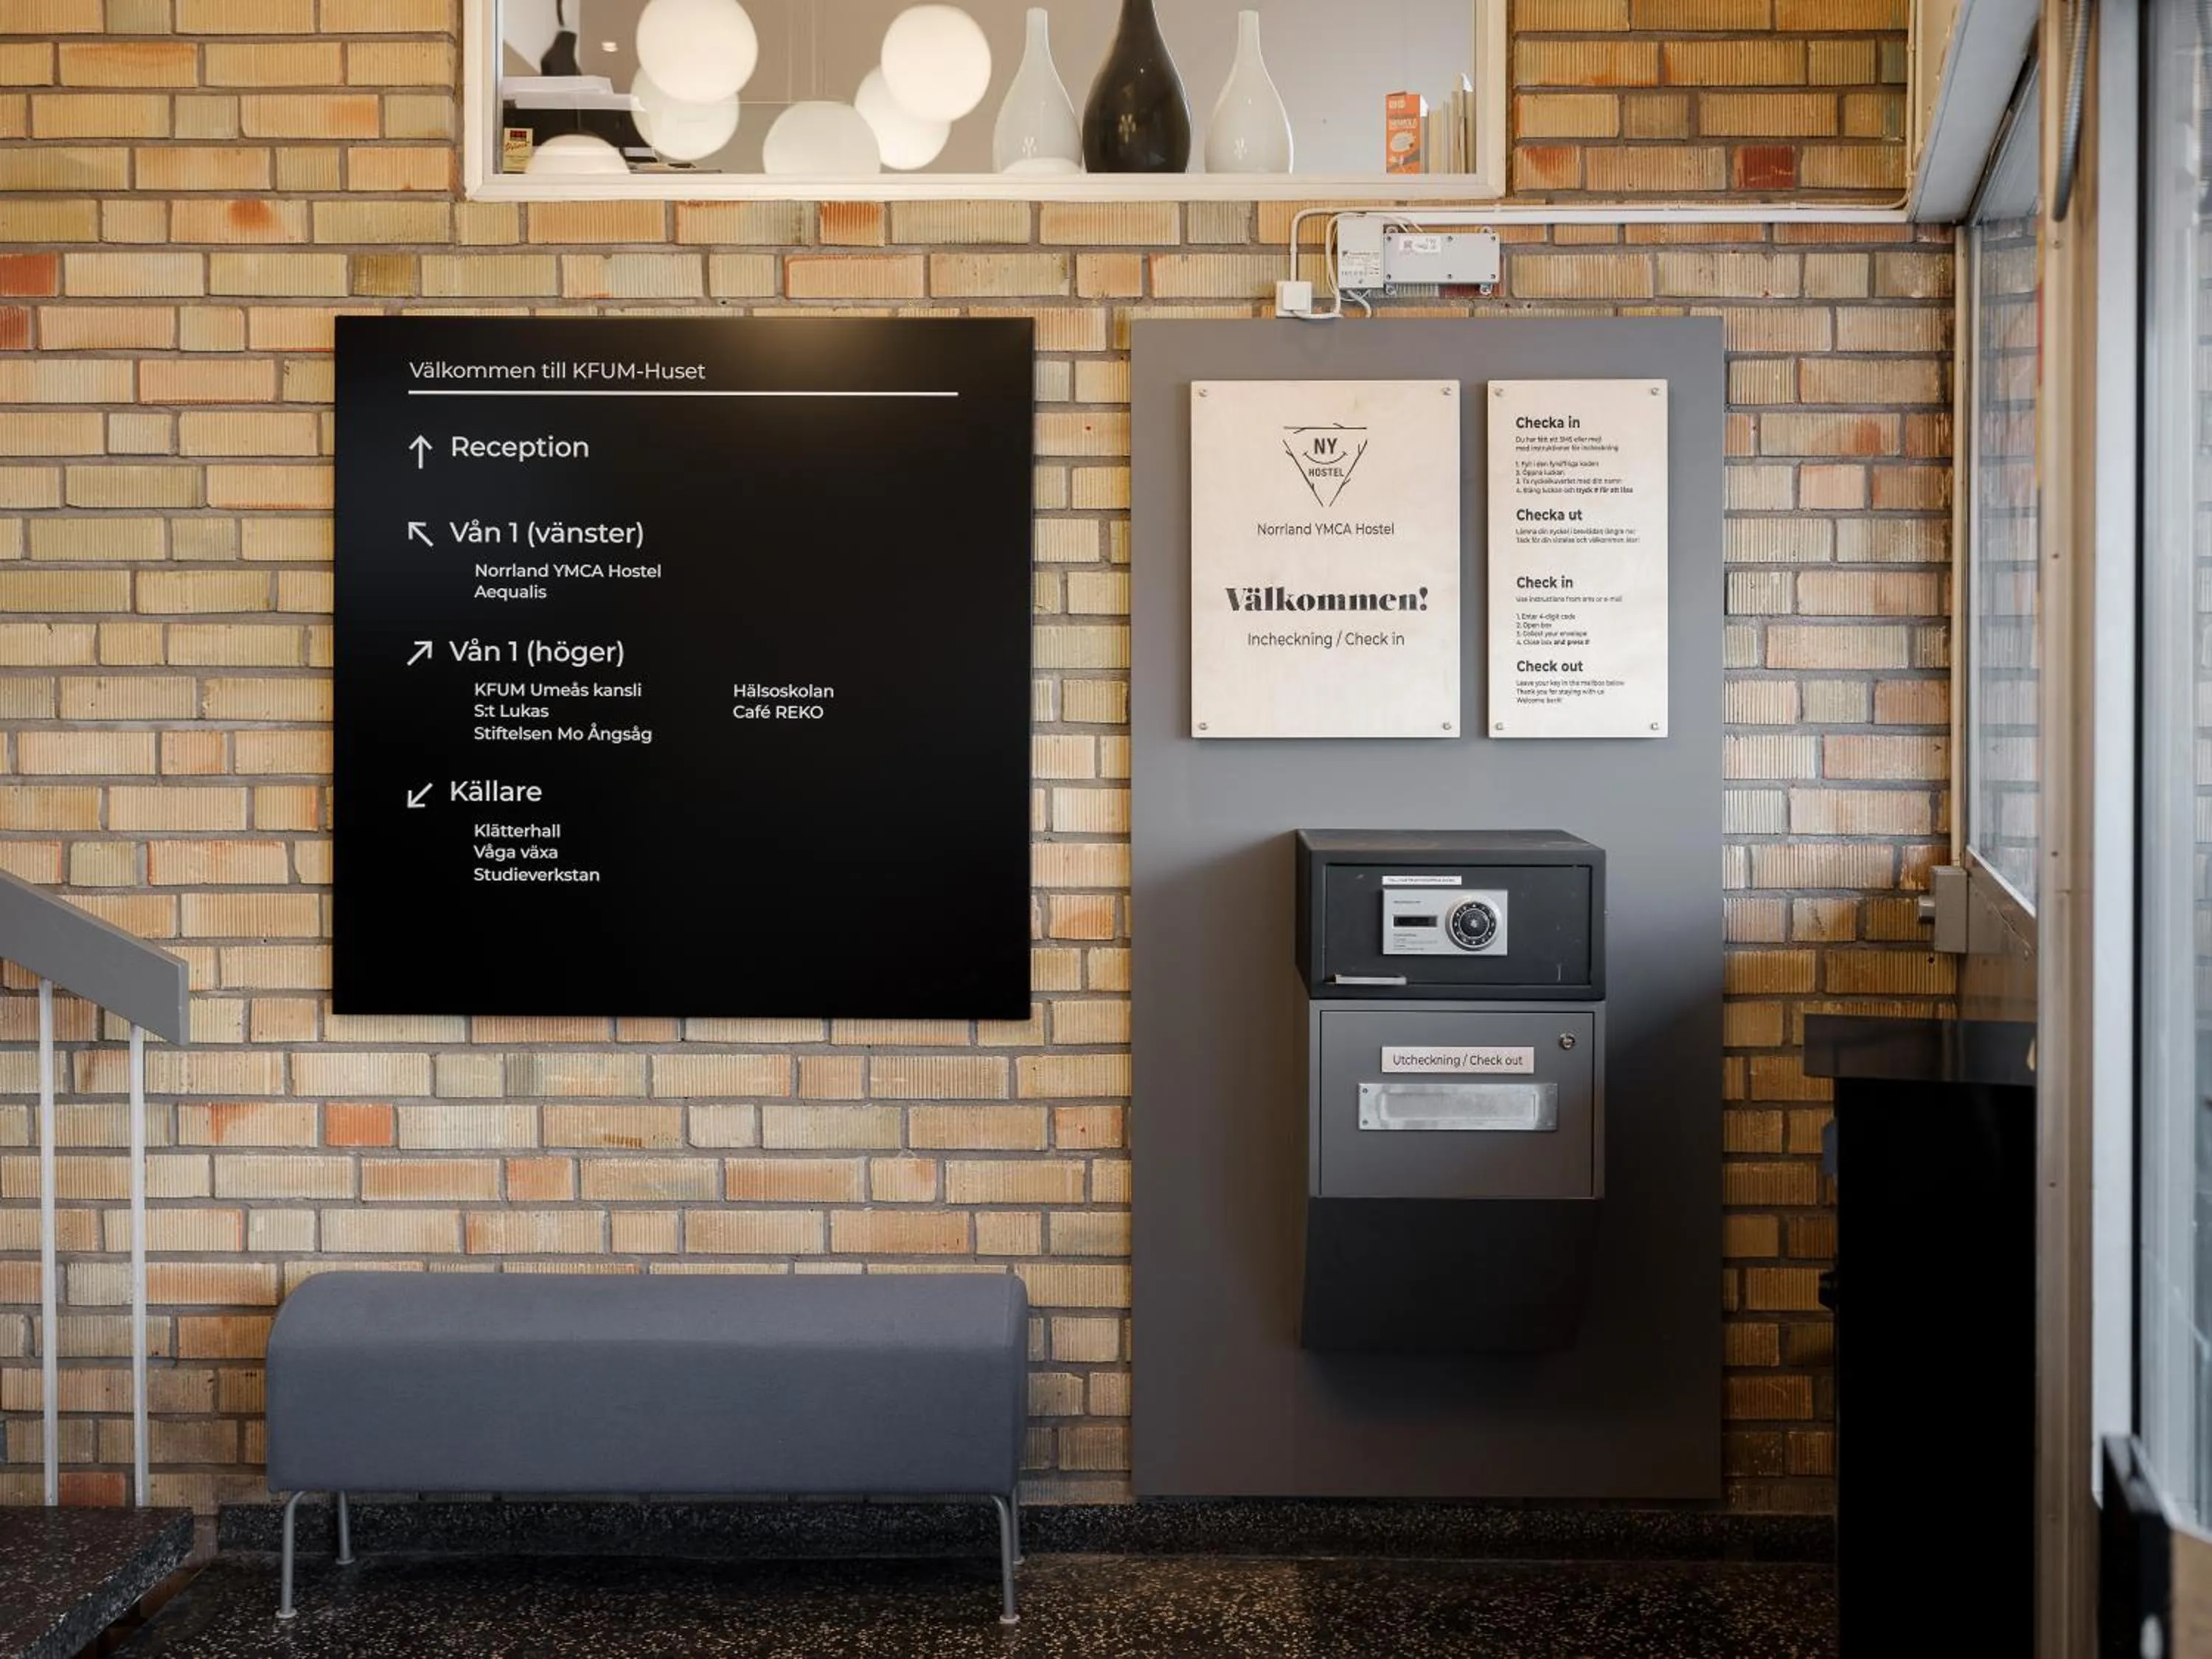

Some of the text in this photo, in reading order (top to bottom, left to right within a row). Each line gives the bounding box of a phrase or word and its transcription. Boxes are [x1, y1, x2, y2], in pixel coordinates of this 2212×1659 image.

[409, 361, 706, 380] Välkommen till KFUM-Huset
[1516, 416, 1579, 428] Checka in
[452, 435, 589, 462] Reception
[1313, 437, 1338, 455] NY
[1308, 467, 1345, 478] HOSTEL
[1517, 509, 1582, 521] Checka ut
[449, 518, 644, 549] Vån 1 (vänster)
[1258, 523, 1394, 535] Norrland YMCA Hostel
[475, 563, 661, 578] Norrland YMCA Hostel
[1517, 575, 1573, 588] Check in
[473, 584, 547, 602] Aequalis
[1226, 587, 1427, 611] Välkommen!
[1248, 633, 1332, 649] Incheckning
[1345, 633, 1388, 645] Check
[1392, 632, 1404, 645] in
[448, 638, 624, 667] Vån 1 (höger)
[1517, 661, 1582, 672] Check out
[475, 681, 641, 697] KFUM Umeås kansli
[734, 684, 834, 698] Hälsoskolan
[474, 703, 549, 718] S:t Lukas
[732, 704, 824, 719] Café REKO
[474, 723, 653, 744] Stiftelsen Mo Ångsåg
[451, 779, 543, 802] Källare
[474, 823, 561, 838] Klätterhall
[473, 843, 558, 862] Våga växa
[473, 866, 600, 882] Studieverkstan
[1394, 1055, 1460, 1068] Utcheckning
[1470, 1055, 1503, 1065] Check
[1506, 1057, 1522, 1065] out
